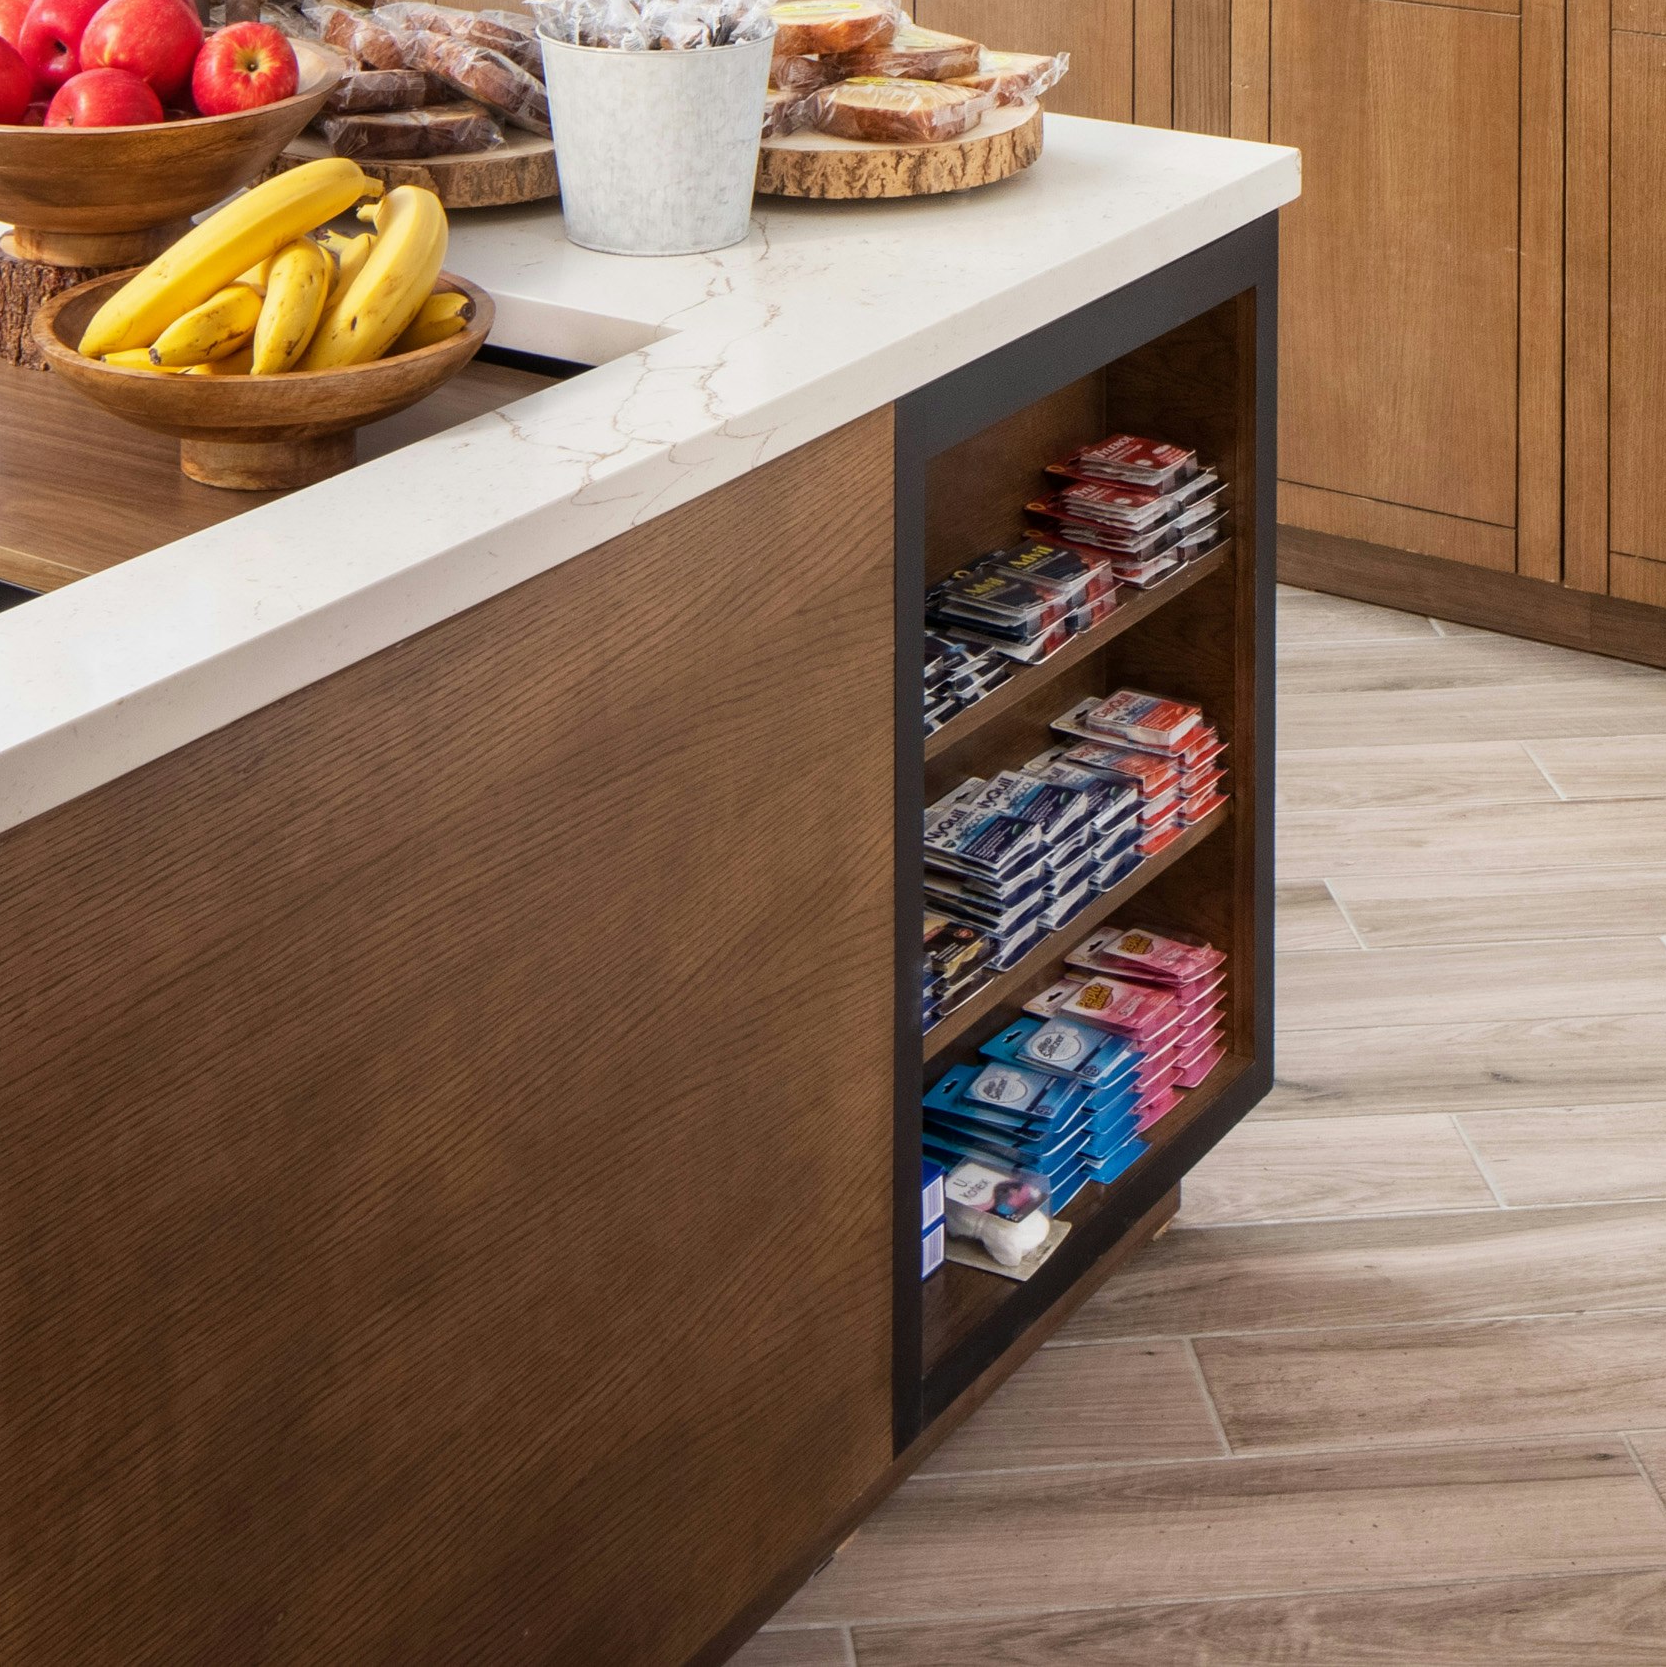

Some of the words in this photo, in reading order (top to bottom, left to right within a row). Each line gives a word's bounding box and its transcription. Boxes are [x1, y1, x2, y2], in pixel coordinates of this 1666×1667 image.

[1090, 435, 1135, 458] TYLENOL
[1009, 545, 1054, 568] Advil
[924, 809, 968, 843] NyQuil
